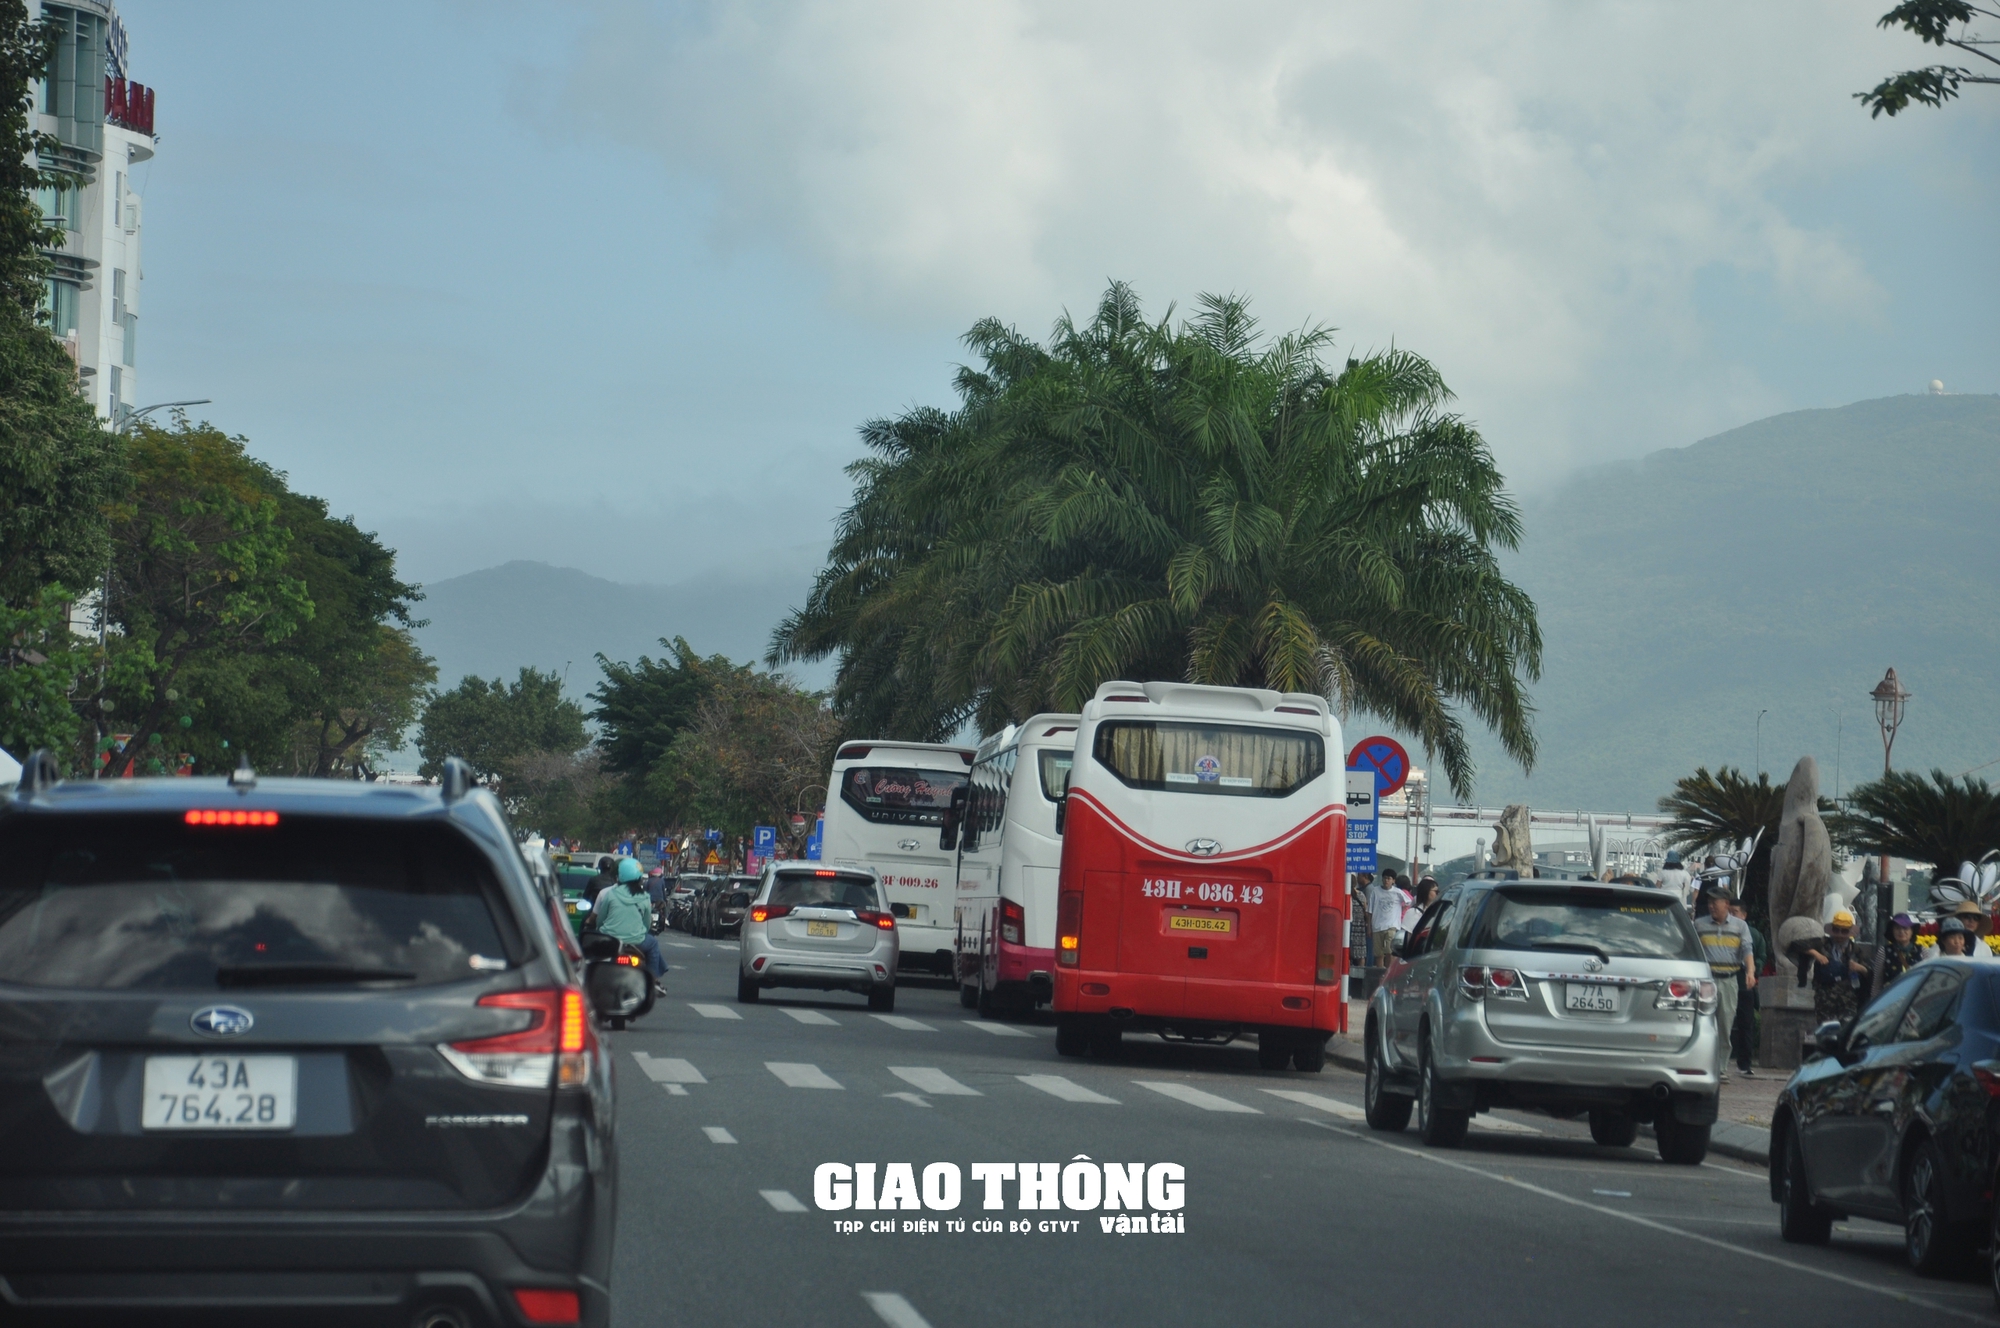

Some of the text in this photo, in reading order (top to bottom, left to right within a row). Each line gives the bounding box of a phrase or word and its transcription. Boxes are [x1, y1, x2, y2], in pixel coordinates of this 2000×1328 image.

[1354, 822, 1374, 831] BUÝT
[1348, 831, 1368, 839] STOP
[1141, 878, 1264, 904] 43H 036.42
[1581, 985, 1604, 998] 77A
[1572, 998, 1613, 1010] 264.50
[187, 1059, 250, 1089] 43A
[159, 1093, 276, 1124] 764.28
